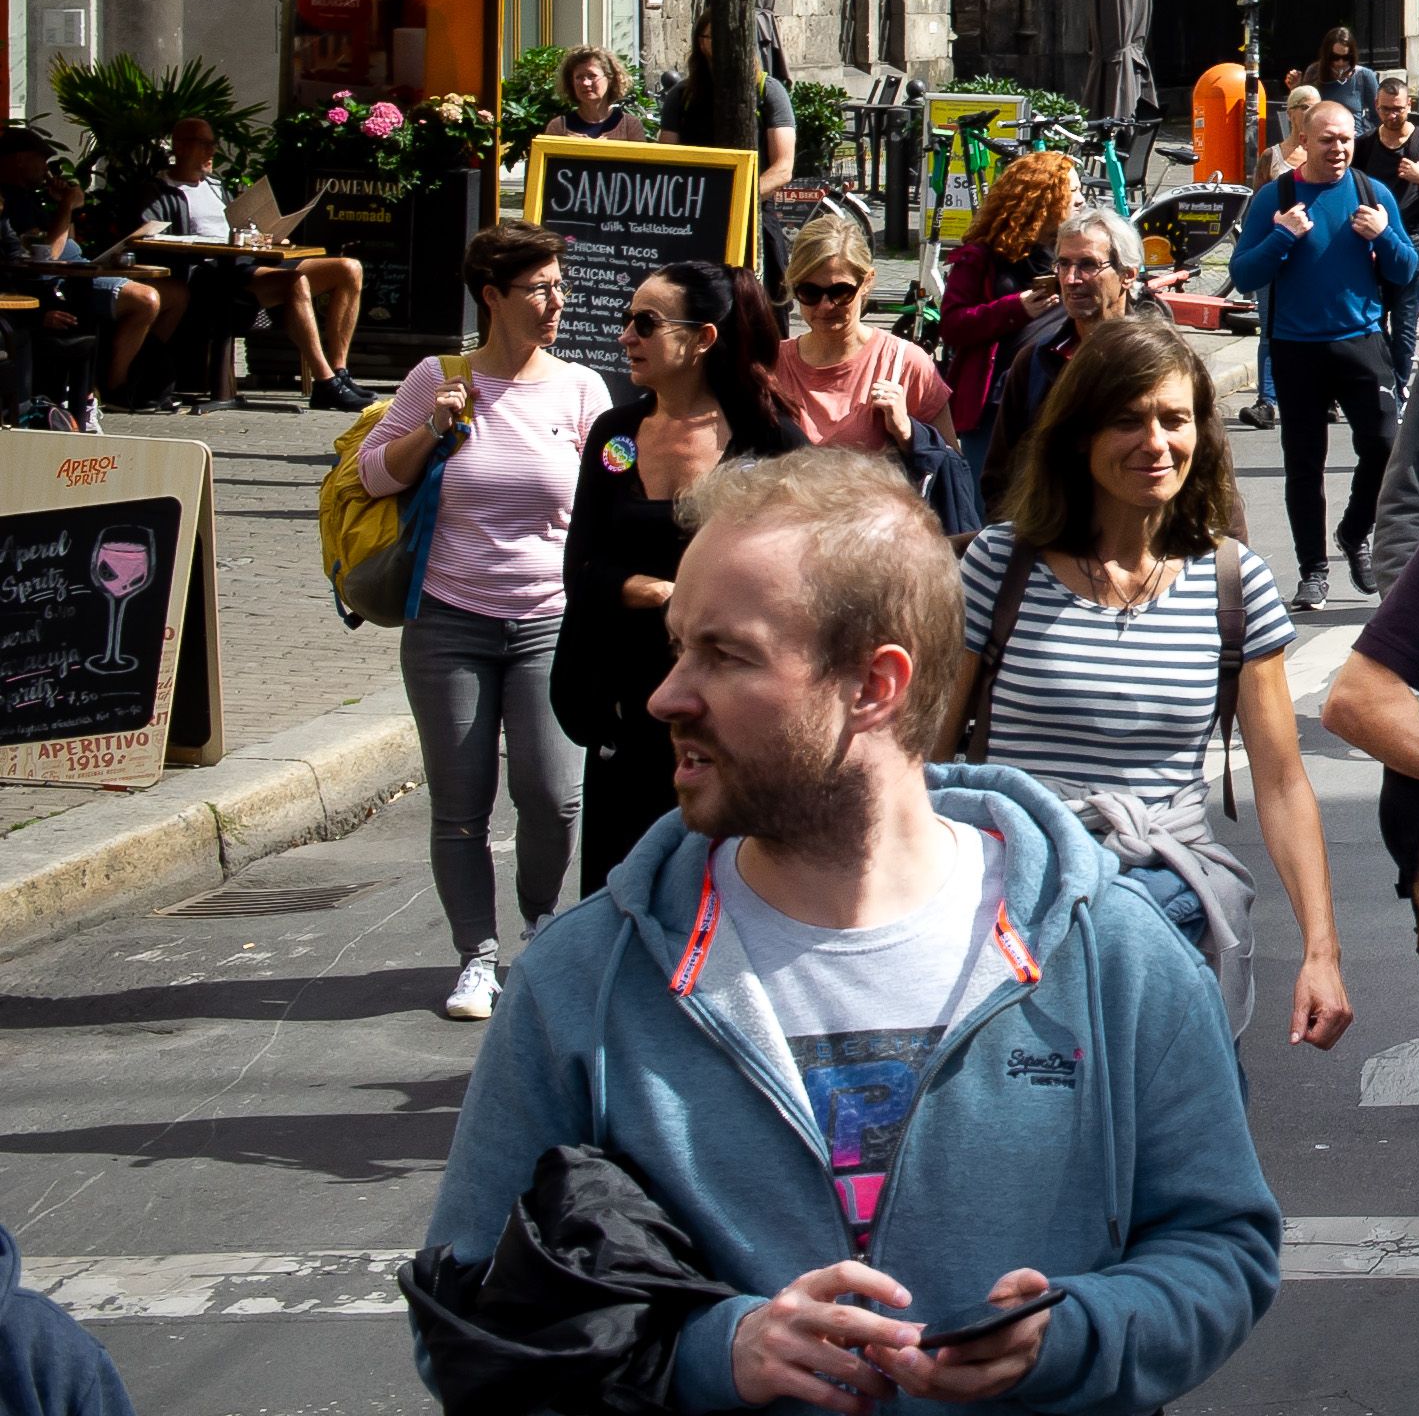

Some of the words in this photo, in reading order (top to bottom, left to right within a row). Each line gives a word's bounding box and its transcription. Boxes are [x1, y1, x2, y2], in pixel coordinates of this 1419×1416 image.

[551, 169, 705, 218] SANDWICH
[621, 246, 659, 259] TACOS
[559, 319, 599, 332] ALAFEL
[549, 346, 583, 358] TUNA
[586, 349, 619, 362] WRAP
[57, 456, 118, 478] APEROL
[66, 471, 107, 487] SPRITZ
[0, 530, 72, 572] Aperol
[0, 567, 69, 603] Spritz
[38, 732, 149, 761] APERITIVO
[66, 752, 115, 772] 1919
